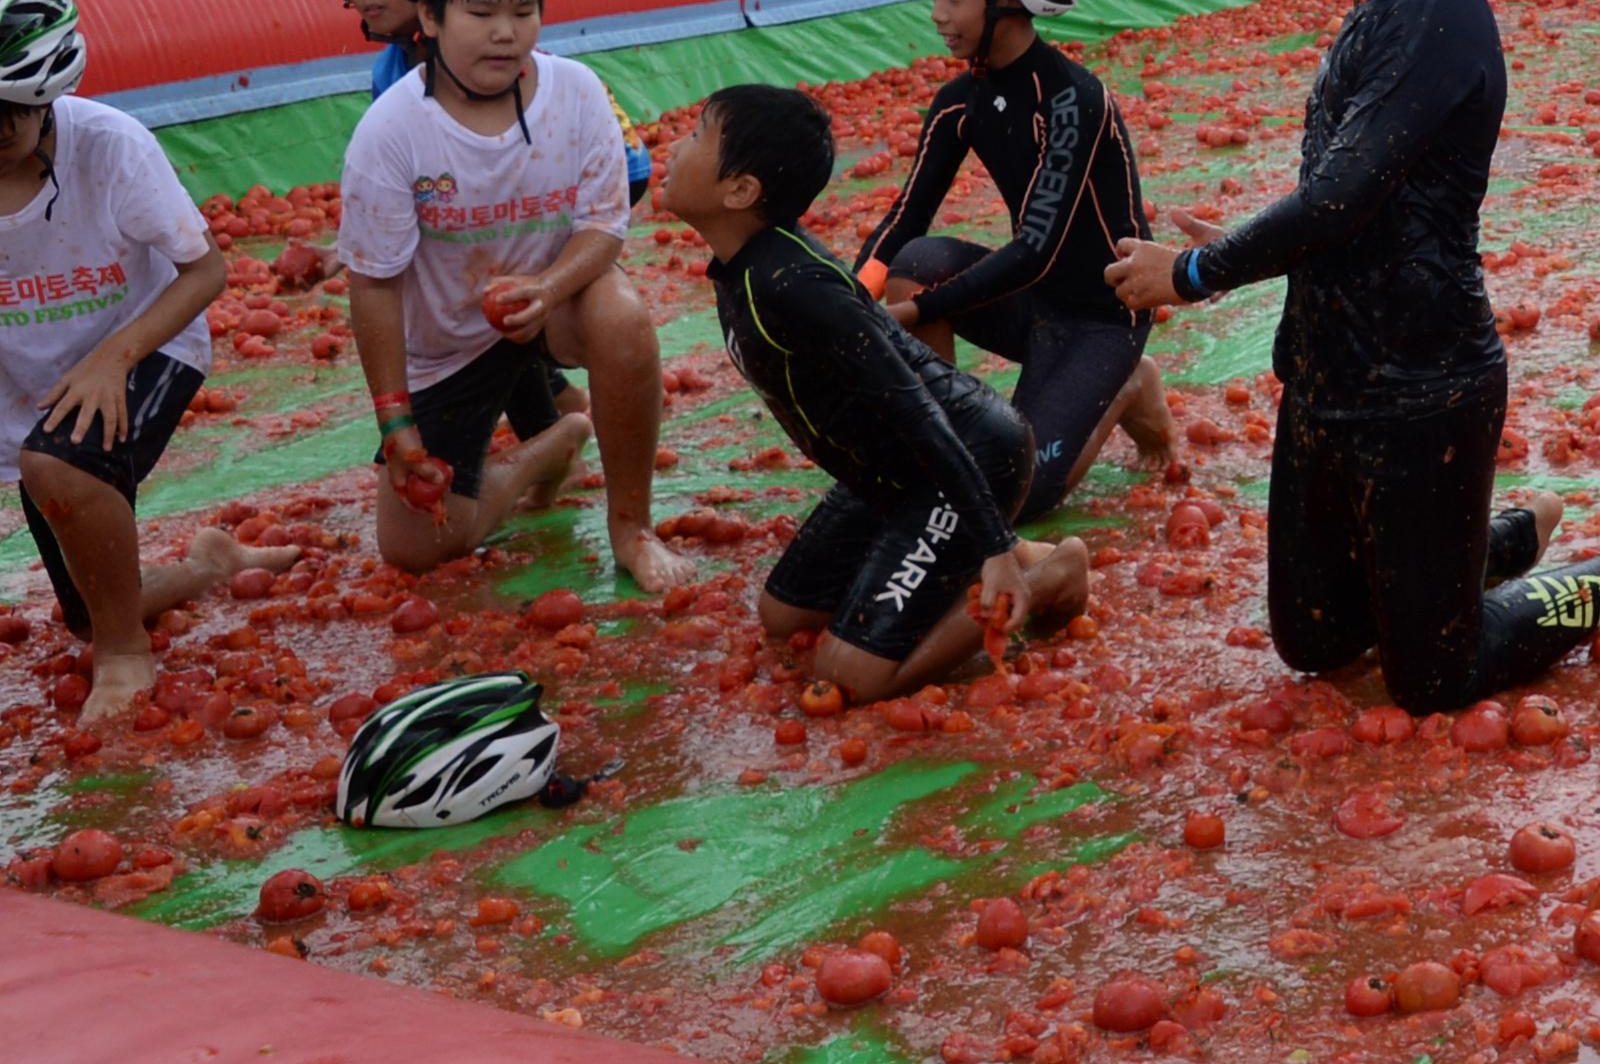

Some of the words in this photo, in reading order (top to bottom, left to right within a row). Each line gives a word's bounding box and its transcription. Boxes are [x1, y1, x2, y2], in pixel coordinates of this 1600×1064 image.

[419, 184, 577, 232] 화천토마토축제
[1021, 86, 1081, 254] DESCENTE
[0, 310, 30, 327] TO
[874, 506, 959, 612] SHARK
